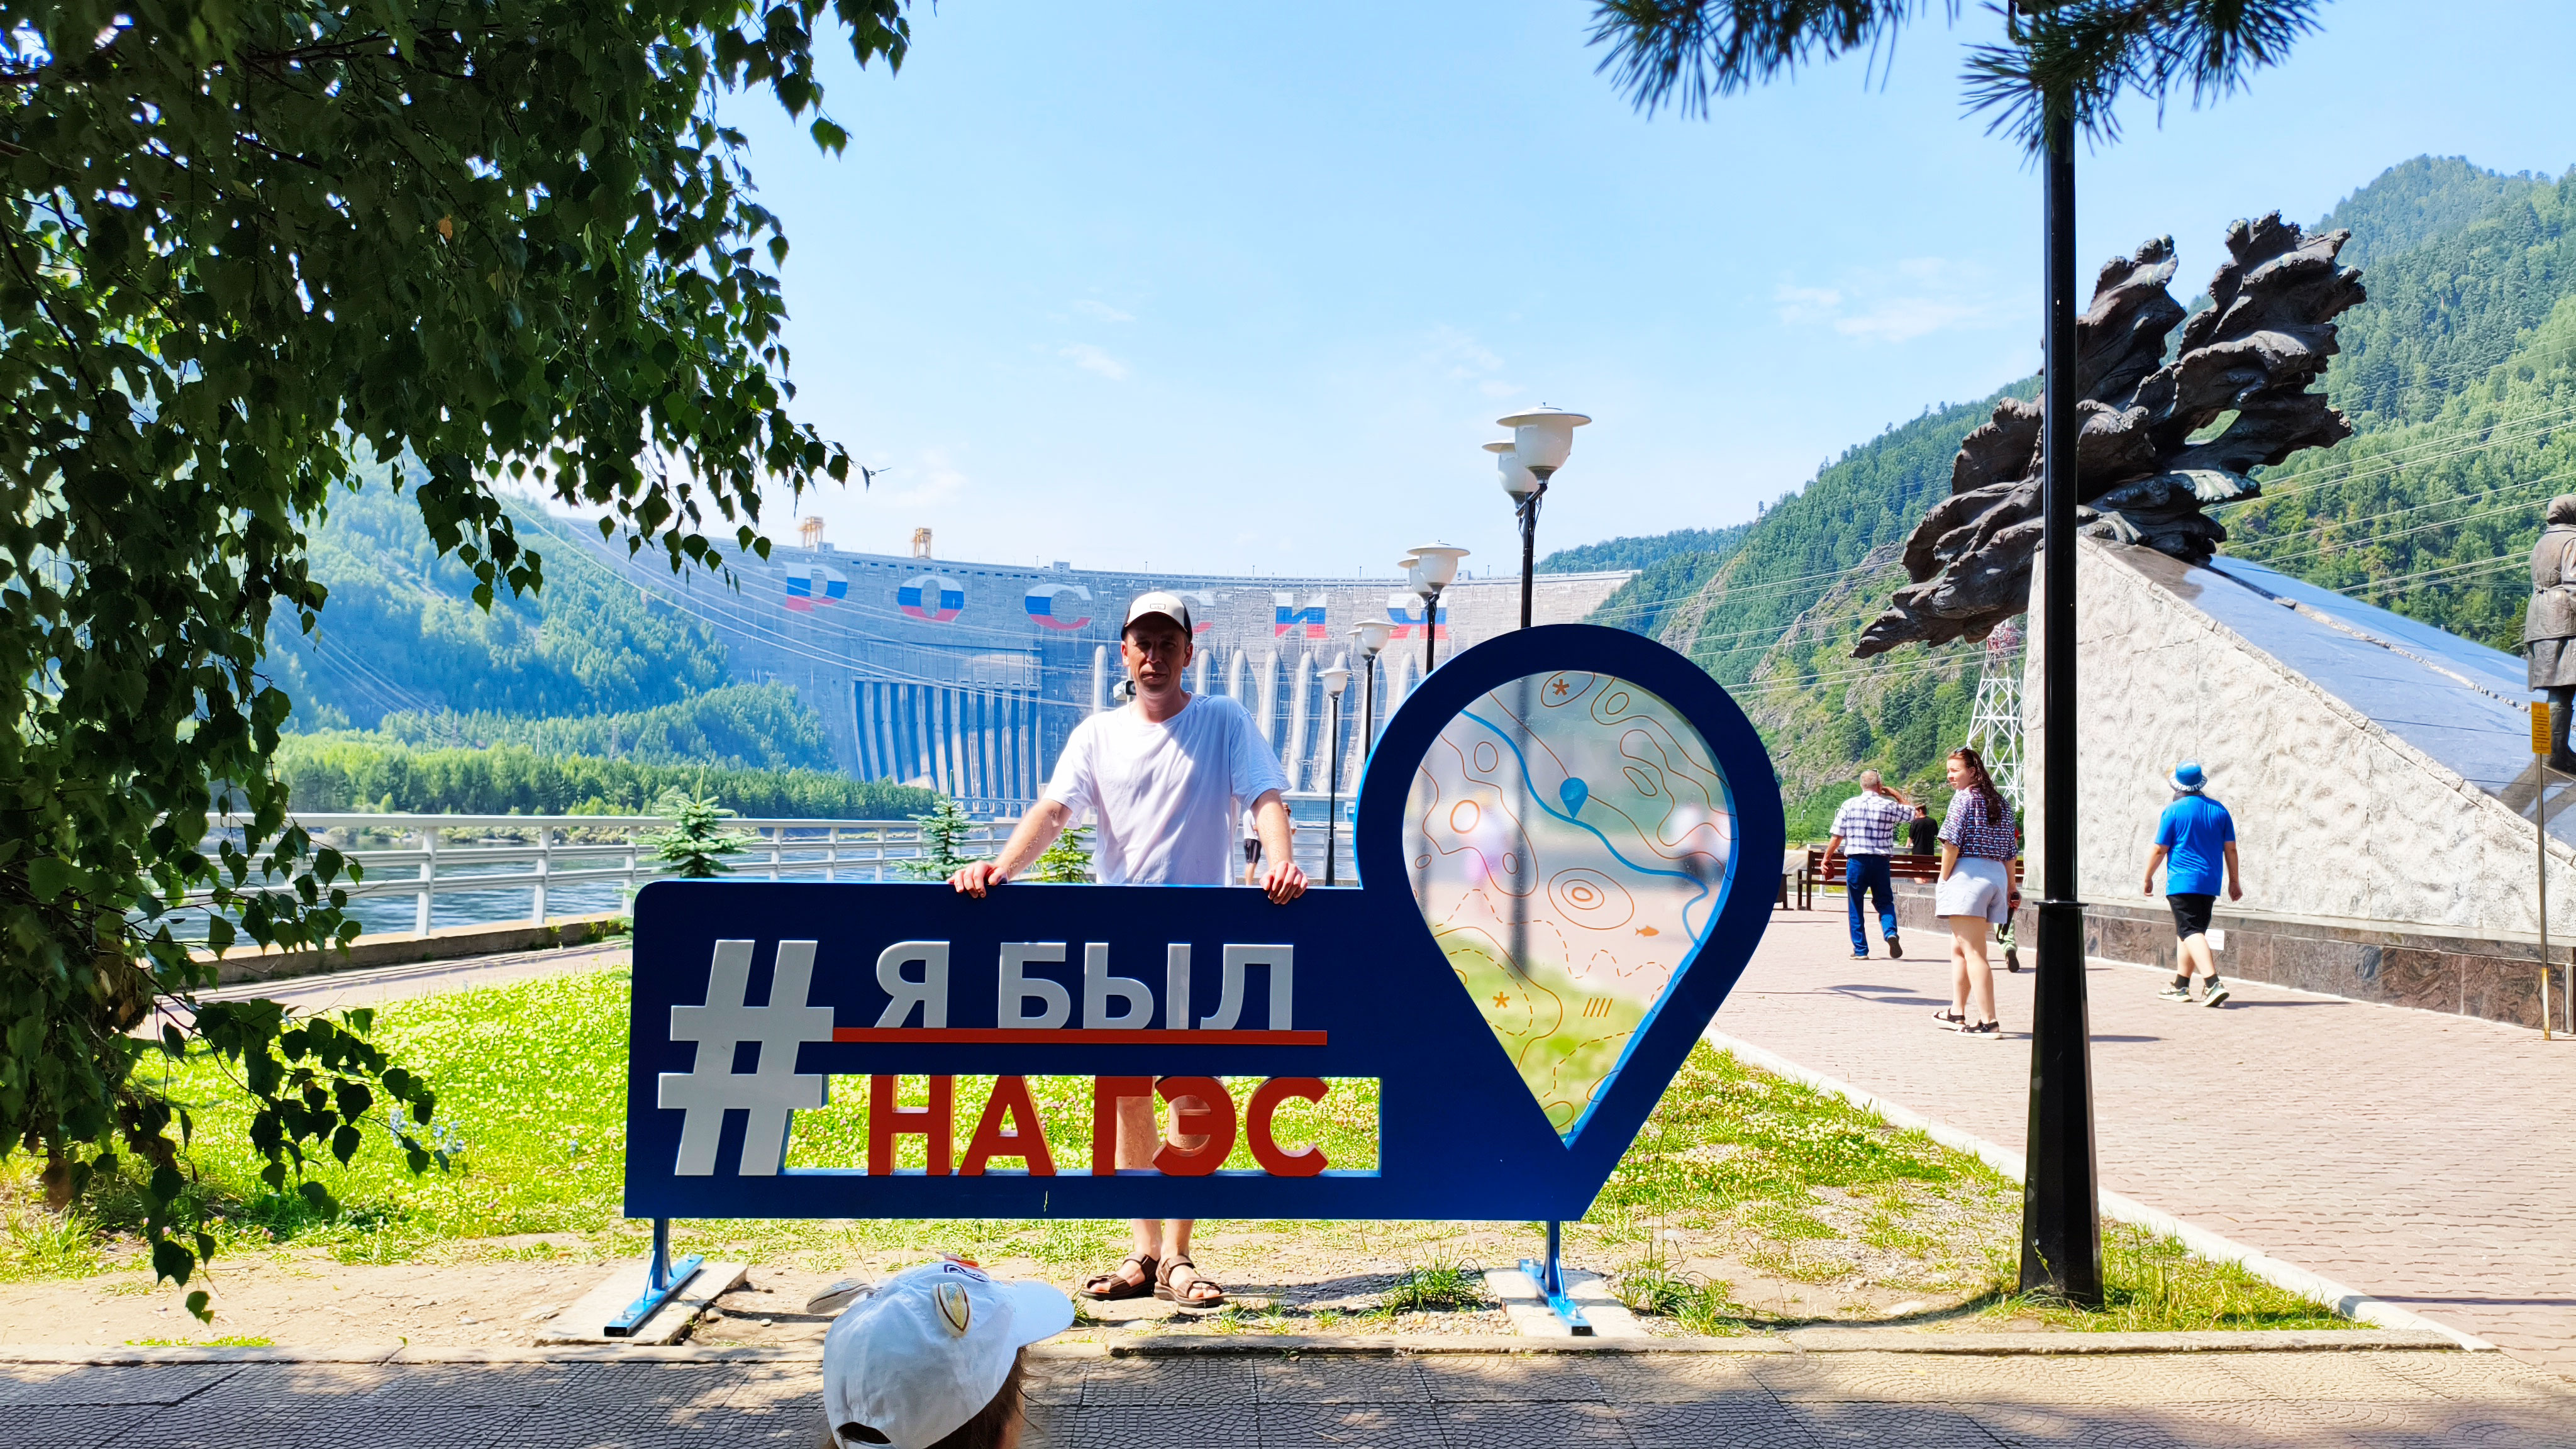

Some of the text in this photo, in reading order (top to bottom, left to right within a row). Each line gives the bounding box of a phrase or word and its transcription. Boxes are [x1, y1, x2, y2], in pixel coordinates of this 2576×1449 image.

[874, 941, 950, 1028] Я
[998, 942, 1294, 1030] БЫЛ
[867, 1074, 1330, 1176] НА ГЭС
